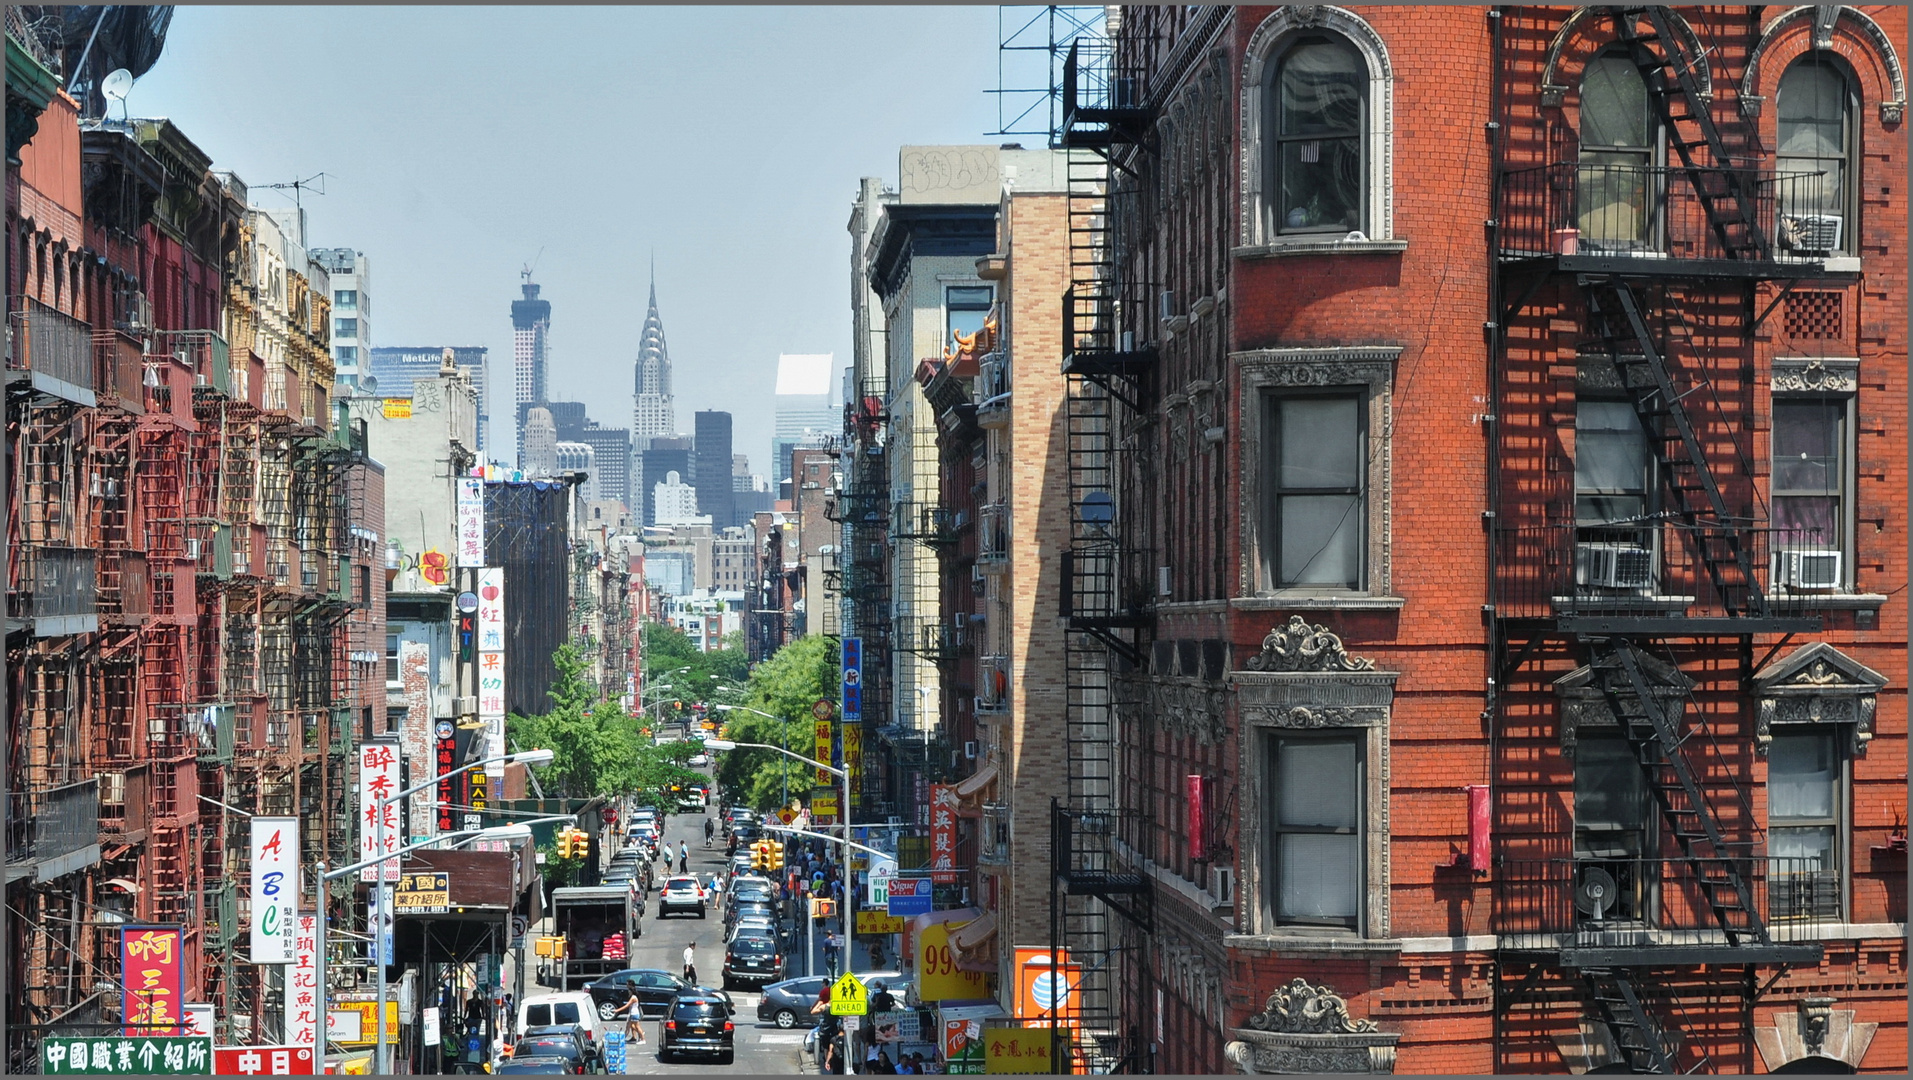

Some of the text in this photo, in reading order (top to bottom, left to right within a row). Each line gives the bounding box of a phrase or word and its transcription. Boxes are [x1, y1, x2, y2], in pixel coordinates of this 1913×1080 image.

[402, 353, 441, 363] MetLife
[461, 617, 472, 660] KTV
[889, 880, 915, 892] Sigue
[46, 1040, 207, 1072] 中國職業介紹所
[990, 1039, 1052, 1057] 金鳳小飯
